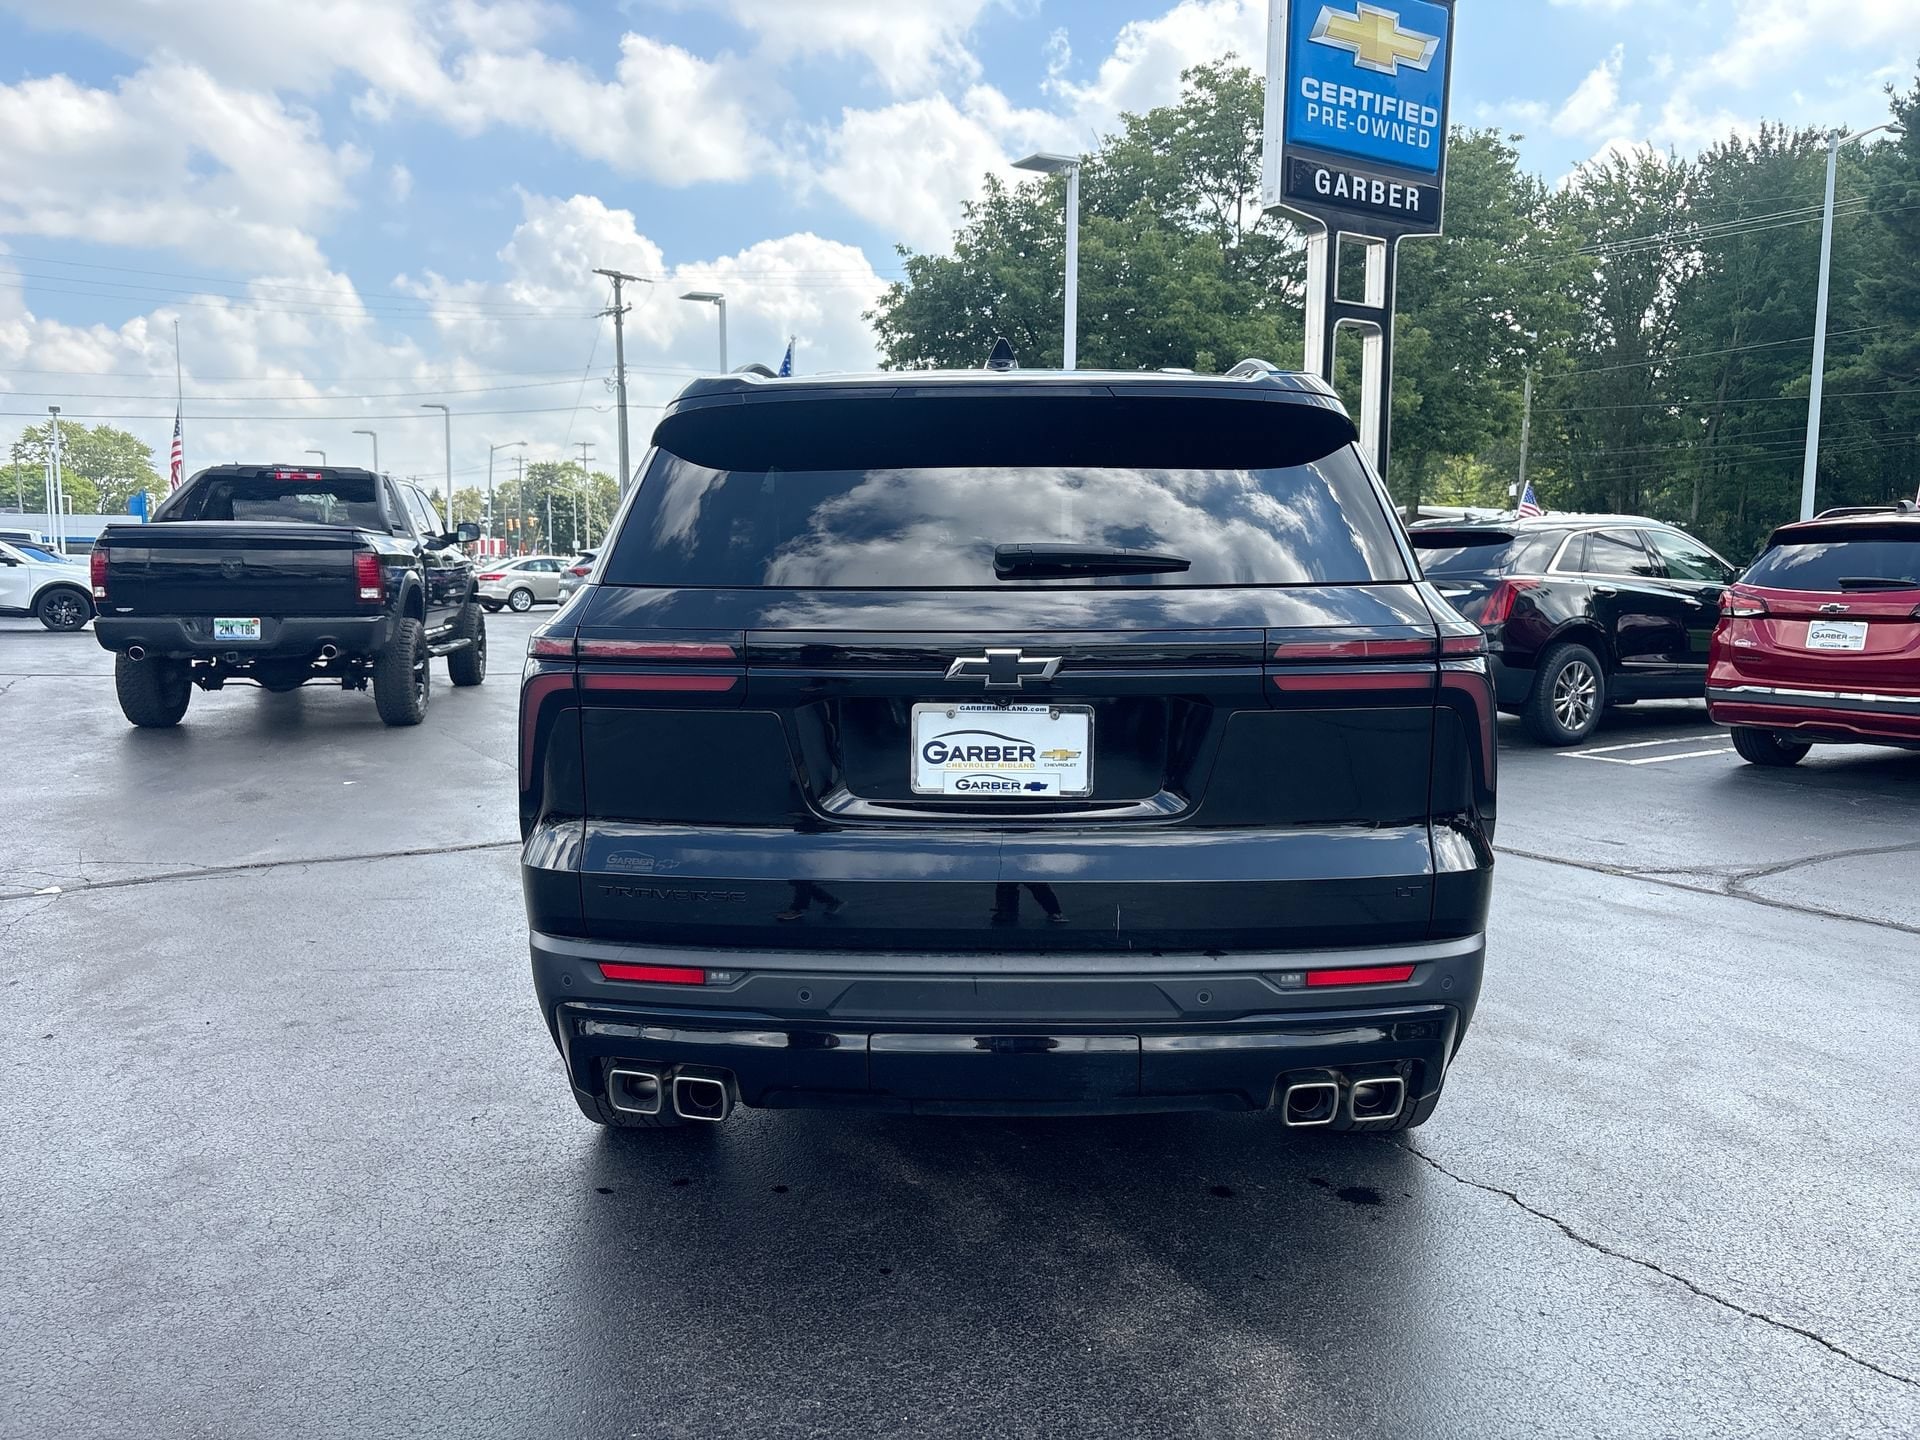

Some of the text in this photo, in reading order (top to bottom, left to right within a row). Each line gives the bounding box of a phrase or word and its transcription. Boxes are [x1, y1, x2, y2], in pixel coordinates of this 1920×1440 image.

[1301, 77, 1438, 128] CERTIFIED
[1306, 102, 1430, 149] PRE-OWNED
[1314, 169, 1420, 212] GARBER
[1811, 631, 1848, 640] GARBER
[922, 740, 1036, 765] GARBER
[955, 778, 1021, 791] GARBER
[606, 854, 655, 866] GARBER
[597, 884, 747, 903] TRAVERSE
